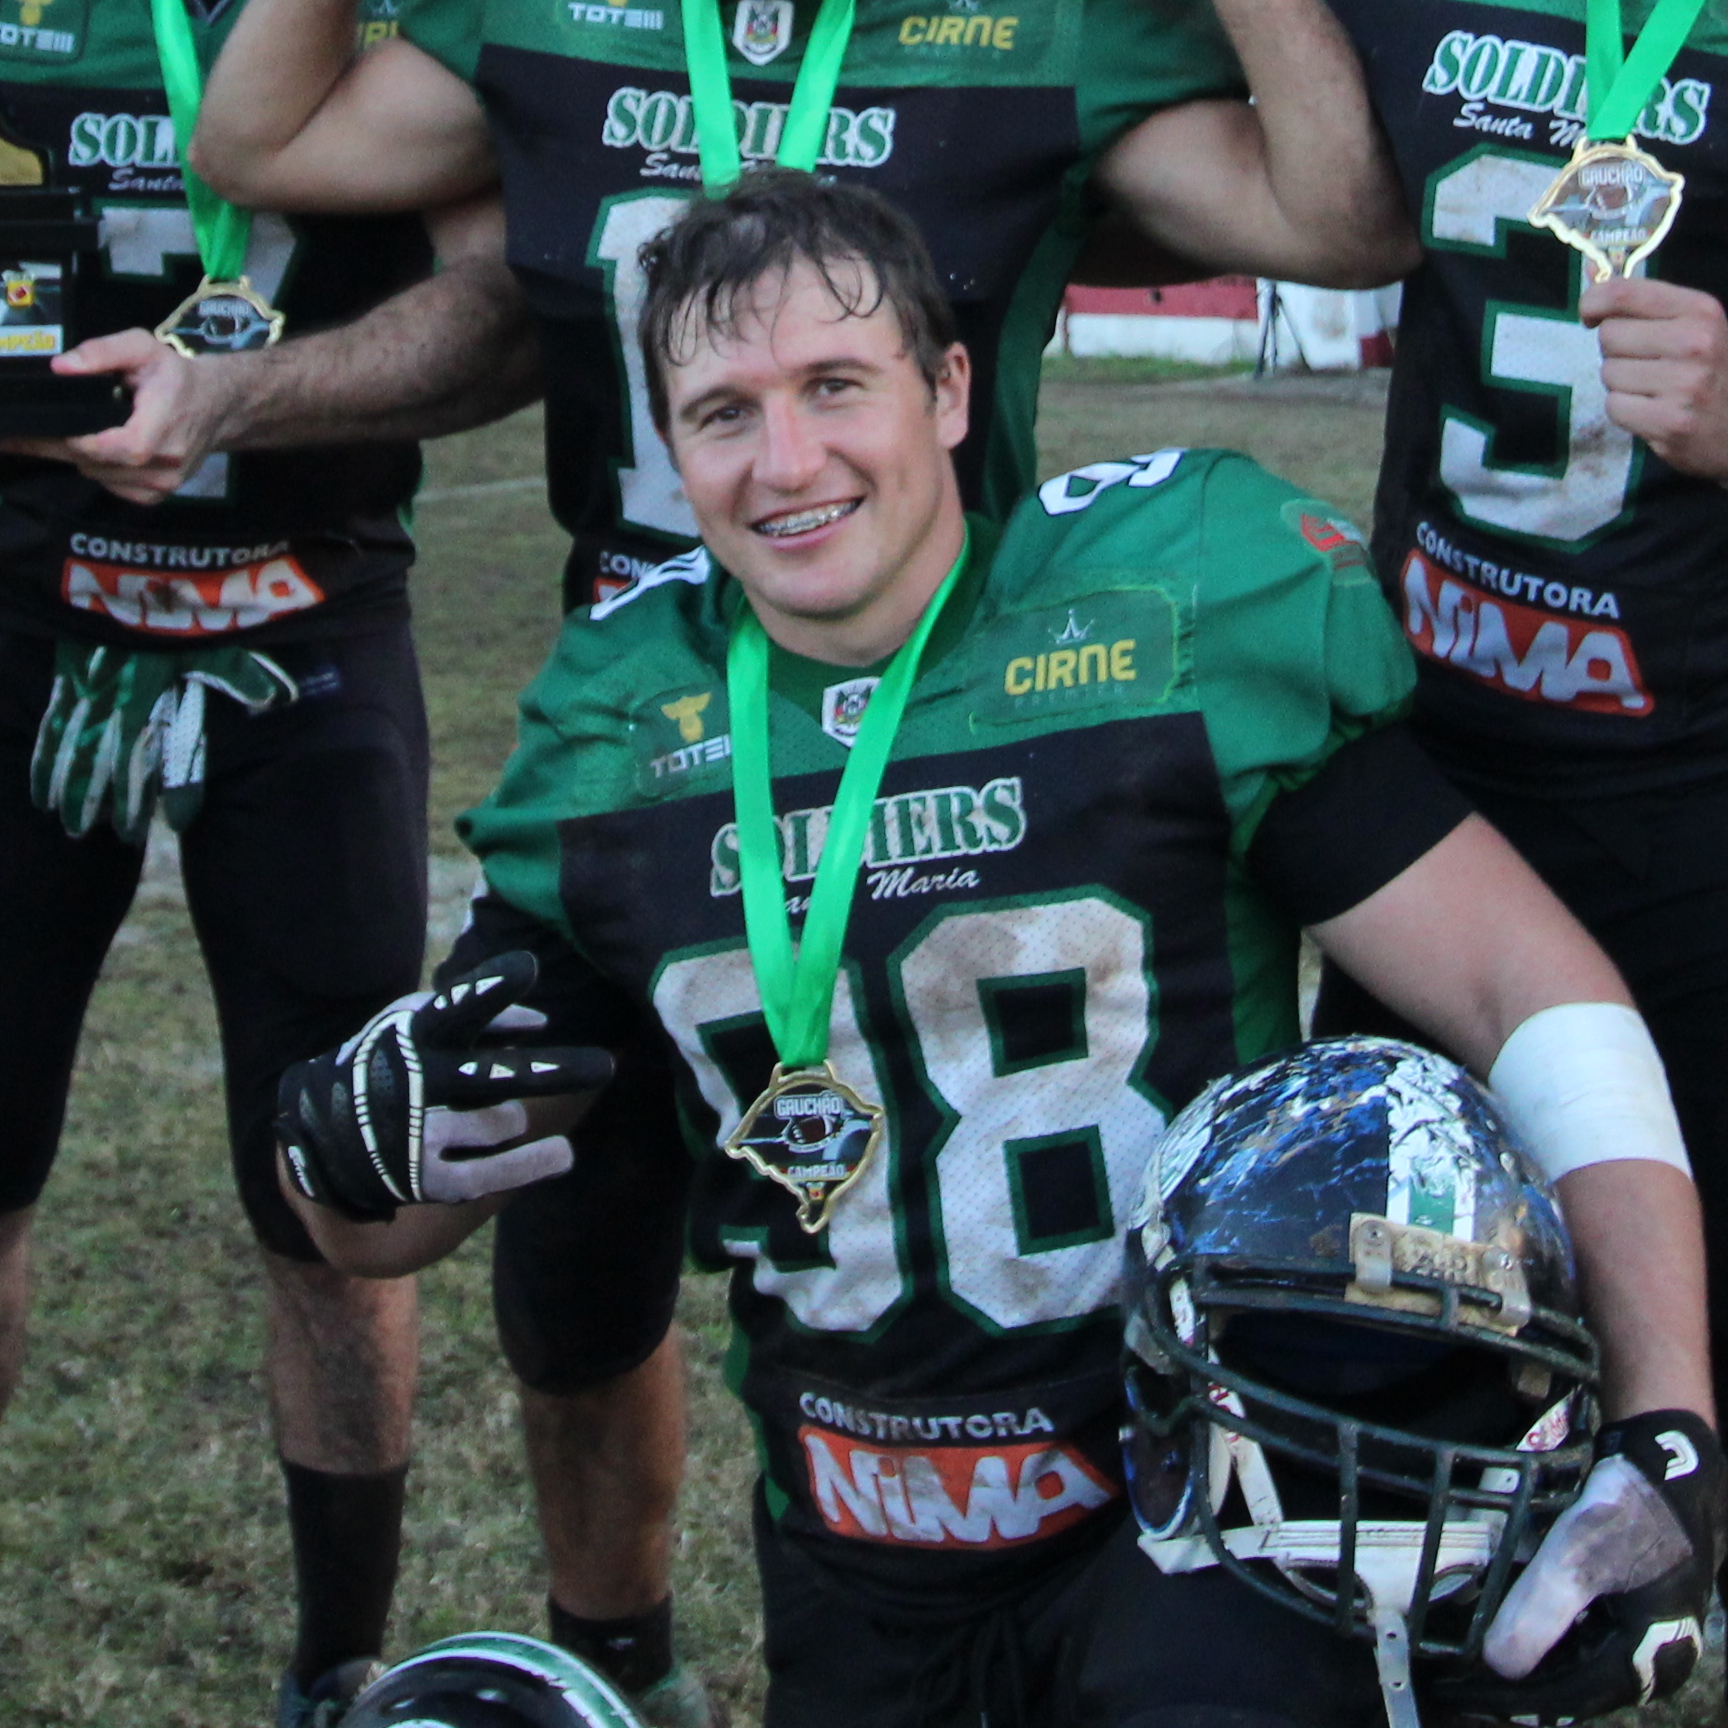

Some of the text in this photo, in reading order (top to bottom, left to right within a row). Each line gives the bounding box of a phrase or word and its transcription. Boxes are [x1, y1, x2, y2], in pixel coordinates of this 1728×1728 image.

[897, 13, 1021, 50] CIRNE
[1451, 101, 1535, 141] Santa
[1424, 148, 1643, 552] 3
[69, 531, 290, 568] CONSTRUTORA
[1413, 519, 1620, 621] CONSTRUTORA
[1003, 638, 1138, 697] CIRNE
[865, 865, 981, 902] Maria
[650, 887, 1177, 1338] 98
[798, 1389, 1056, 1440] CONSTRUTORA
